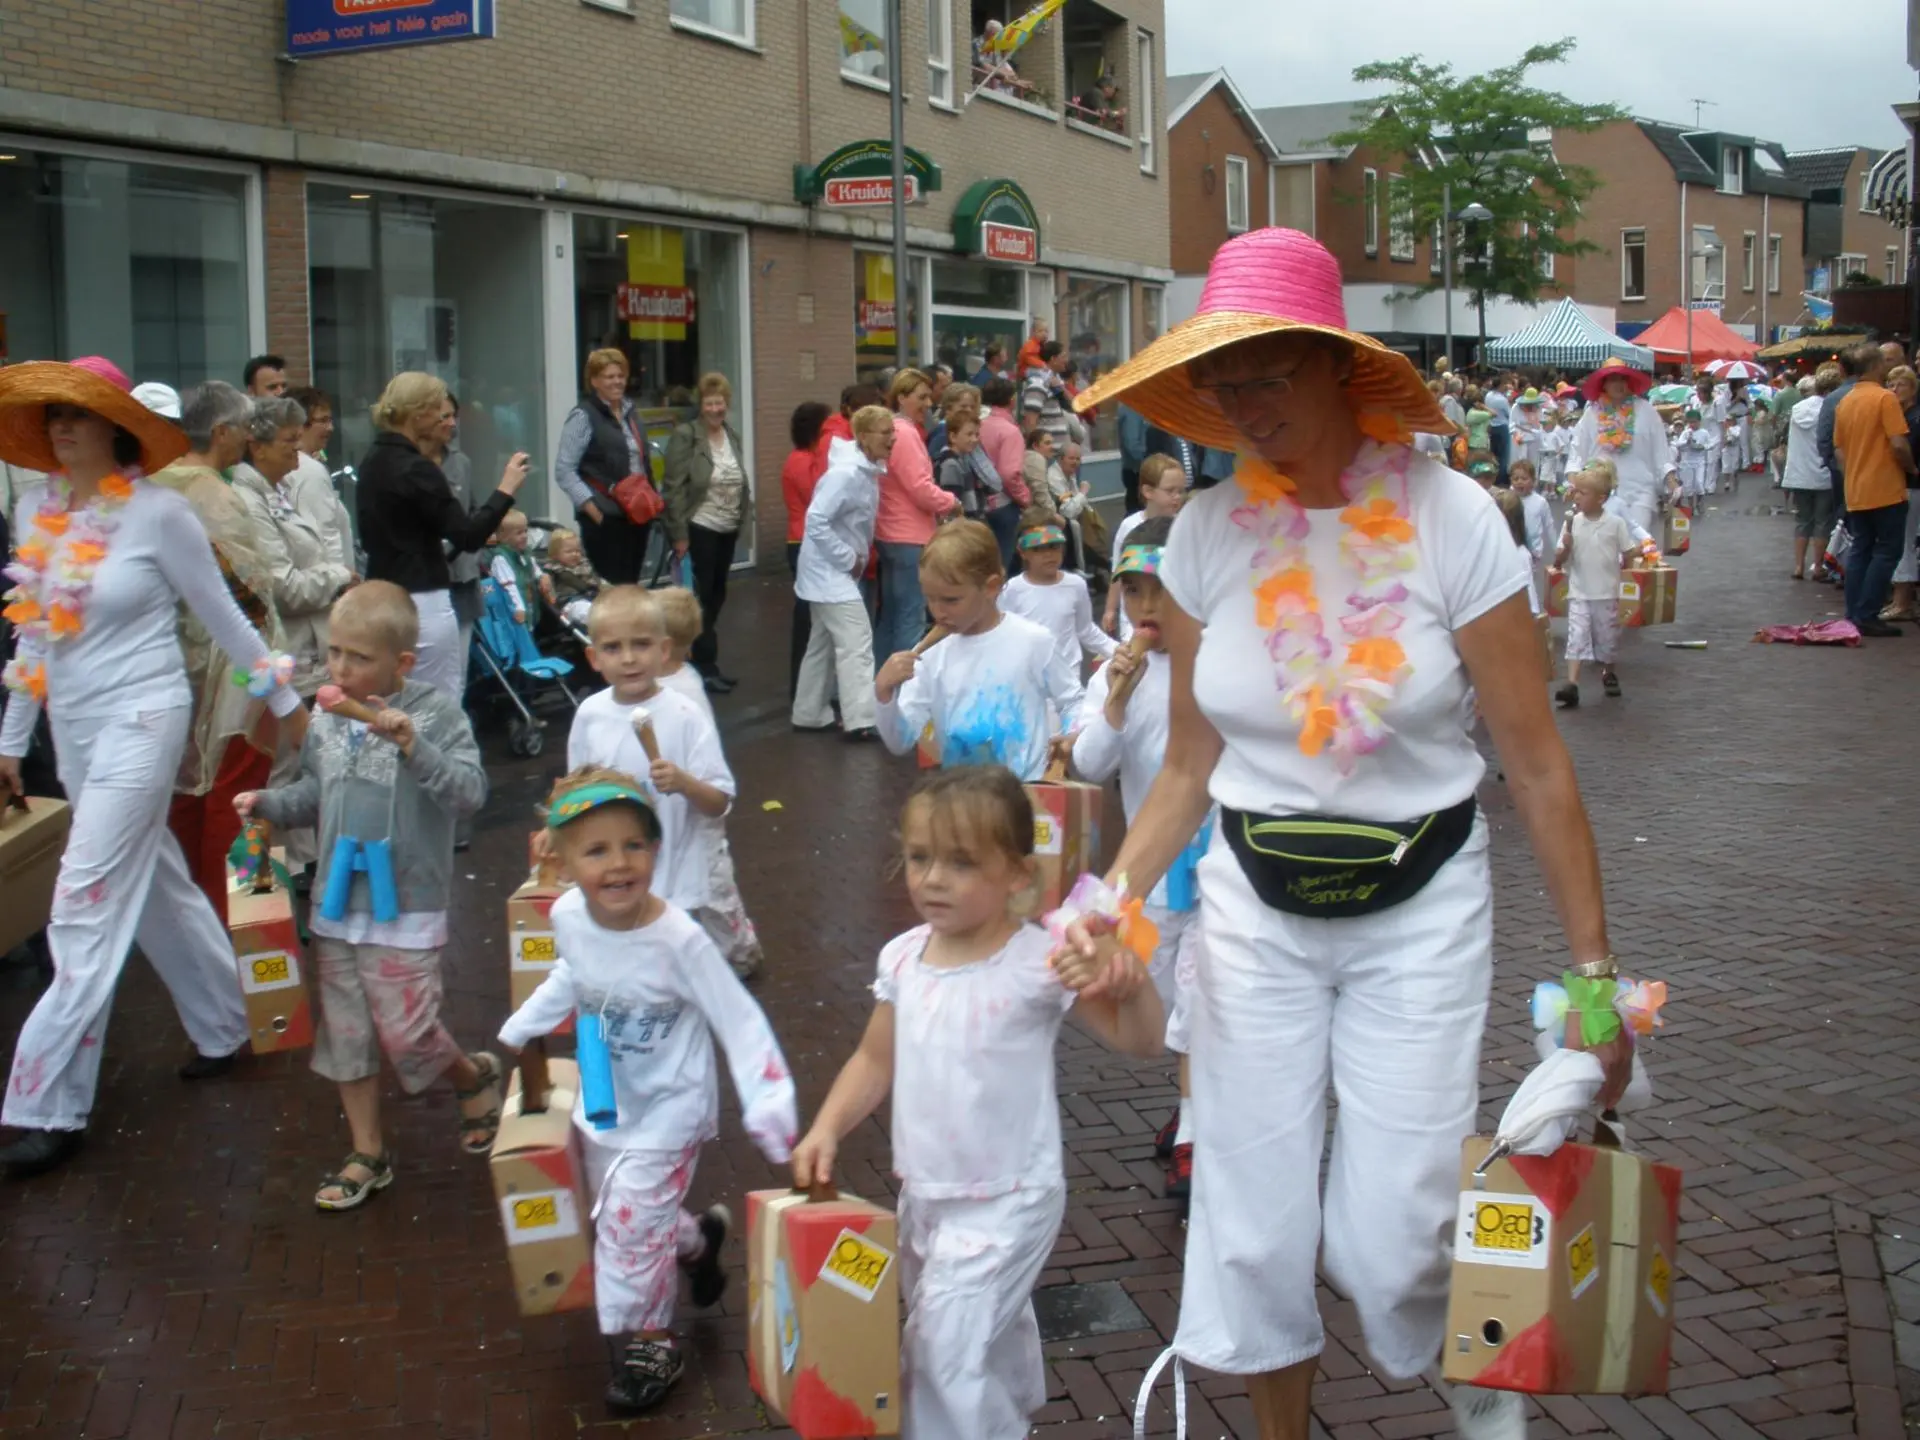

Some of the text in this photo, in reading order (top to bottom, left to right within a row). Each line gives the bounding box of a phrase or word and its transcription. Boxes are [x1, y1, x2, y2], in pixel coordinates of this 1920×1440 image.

[292, 28, 330, 44] mode
[335, 26, 364, 39] voor
[369, 19, 391, 35] het
[431, 11, 467, 31] gezin
[252, 956, 288, 976] Oad
[1477, 1204, 1533, 1236] Oad
[836, 1238, 889, 1278] Oad
